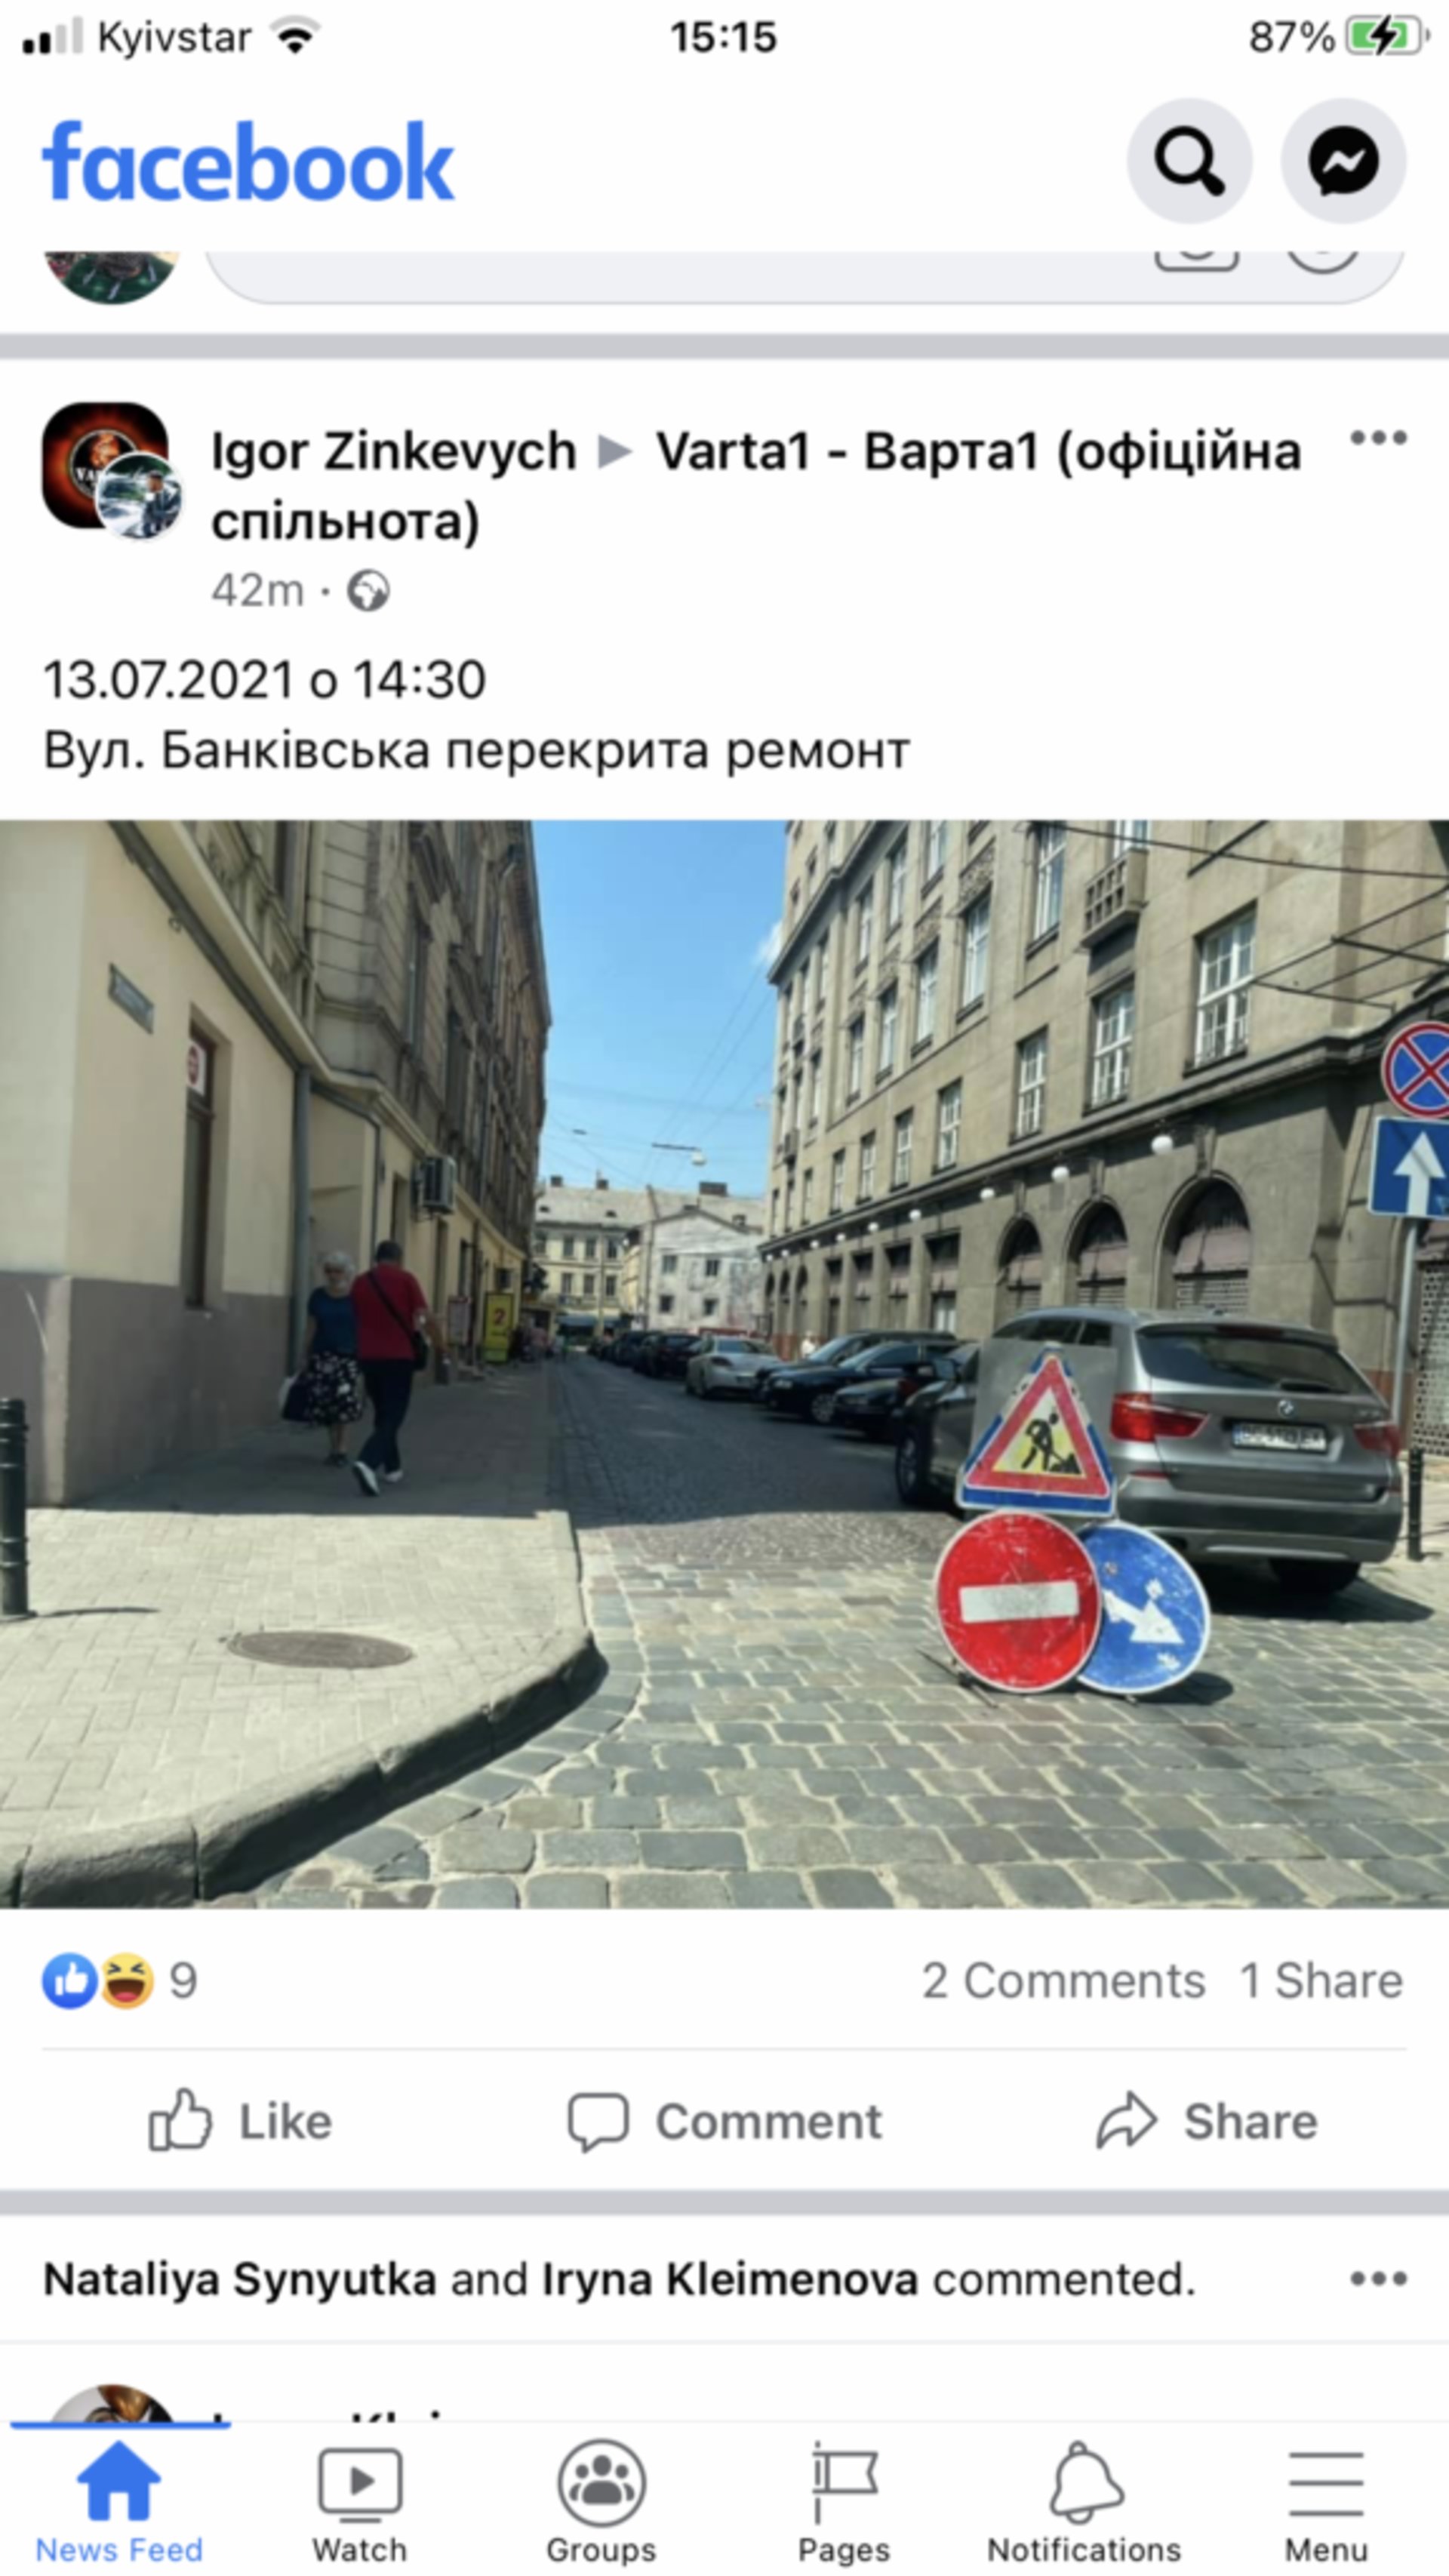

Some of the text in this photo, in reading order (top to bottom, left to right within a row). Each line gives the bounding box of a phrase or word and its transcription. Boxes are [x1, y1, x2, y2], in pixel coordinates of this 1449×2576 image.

[99, 19, 253, 60] Kyivstar
[671, 20, 777, 53] 15:15
[1249, 20, 1337, 53] 87%
[42, 120, 456, 202] facebook
[213, 428, 577, 480] Igor Zinkevych
[656, 430, 808, 471] Varta1
[866, 430, 1036, 480] Варта1
[1058, 426, 1301, 480] (офіційна
[211, 497, 479, 549] спільнота)
[212, 572, 303, 607] 42m
[44, 659, 291, 700] 13.07.2021
[355, 659, 486, 700] 14:30
[45, 728, 910, 778] Вул. Банківська перекрита ремонт
[171, 1962, 197, 1999] 9
[924, 1962, 1206, 1999] 2 Comments
[1241, 1961, 1403, 1999] 1 Share
[242, 2101, 332, 2140] Like
[657, 2103, 882, 2140] Comment
[1186, 2102, 1318, 2141] Share
[45, 2259, 1195, 2305] Nataliya Synyutka and Iryna Kleimenova commented.
[36, 2537, 202, 2562] News Feed
[312, 2537, 407, 2562] Watch
[546, 2538, 657, 2567] Groups
[799, 2538, 891, 2568] Pages
[988, 2537, 1181, 2562] Notifications
[1285, 2538, 1367, 2562] Menu
